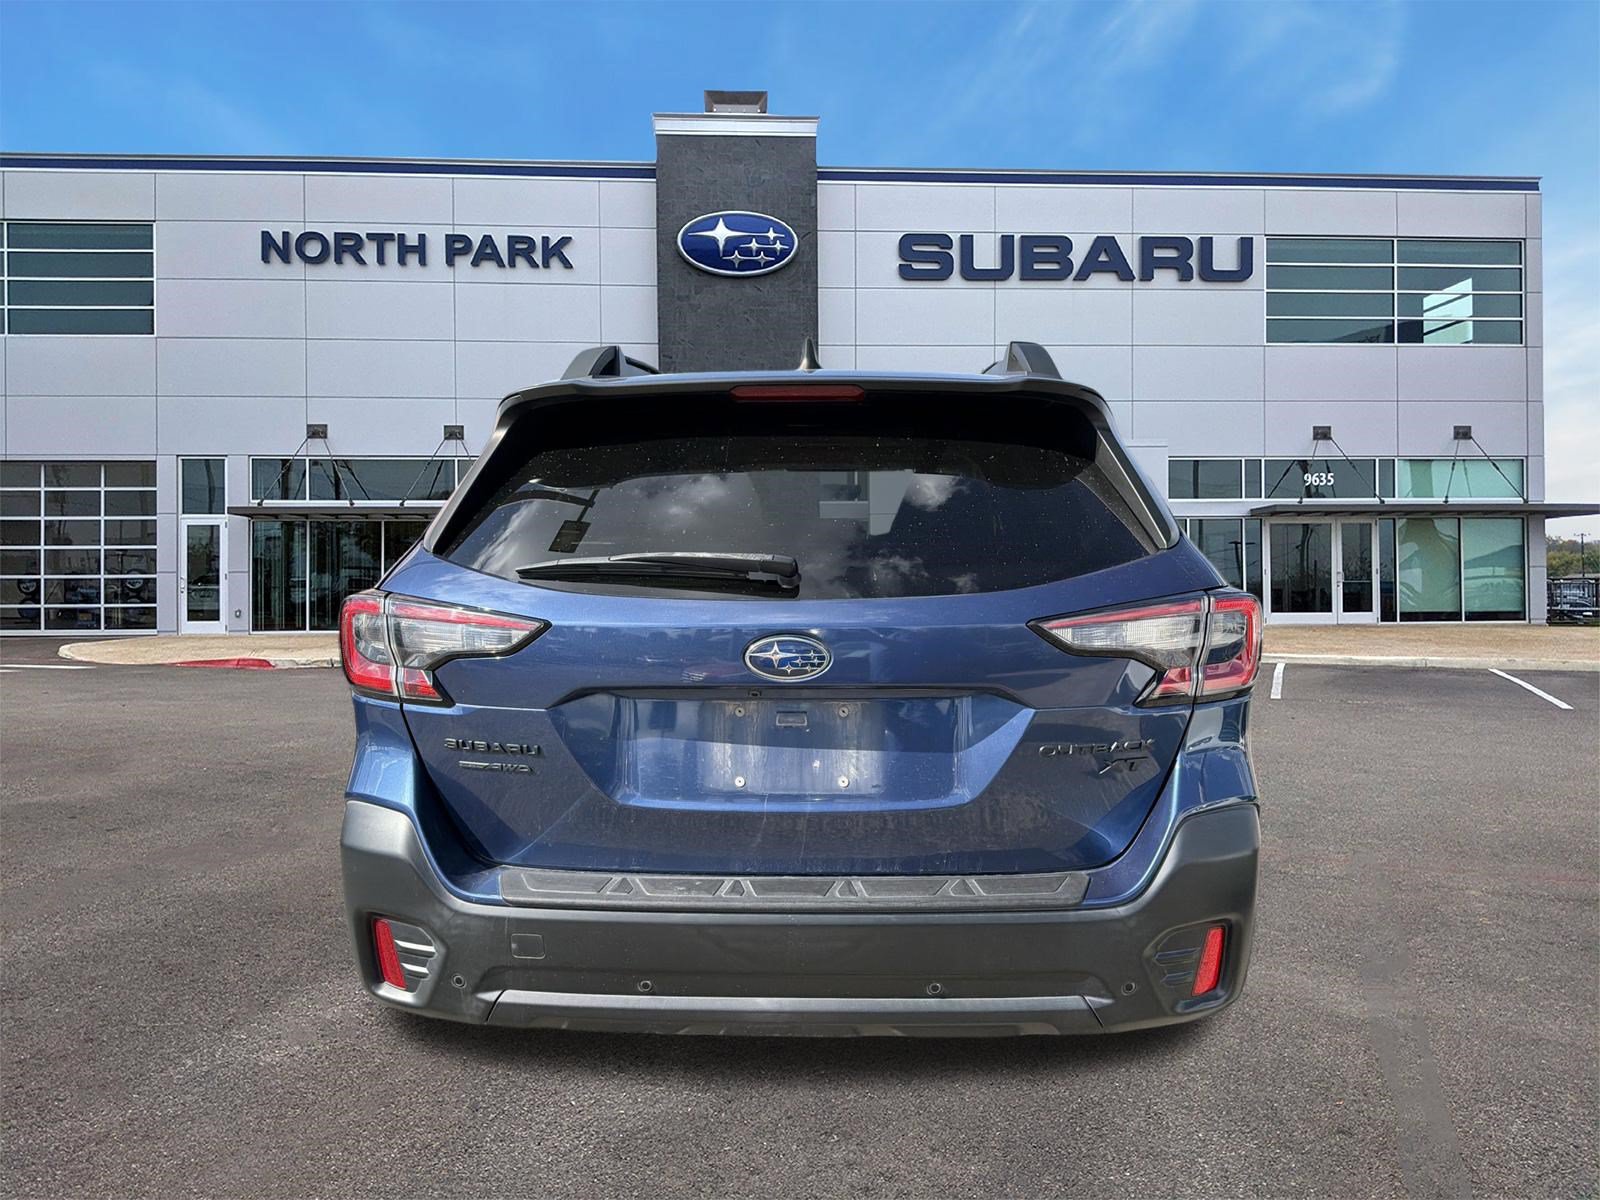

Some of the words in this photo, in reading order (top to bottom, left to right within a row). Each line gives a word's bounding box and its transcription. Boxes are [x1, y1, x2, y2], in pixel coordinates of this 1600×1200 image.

[260, 230, 427, 267] NORTH
[445, 233, 574, 270] PARK
[898, 232, 1254, 283] SUBARU
[1303, 472, 1335, 486] 9635
[443, 737, 541, 757] SUBARU
[1038, 738, 1154, 758] OUTBACK
